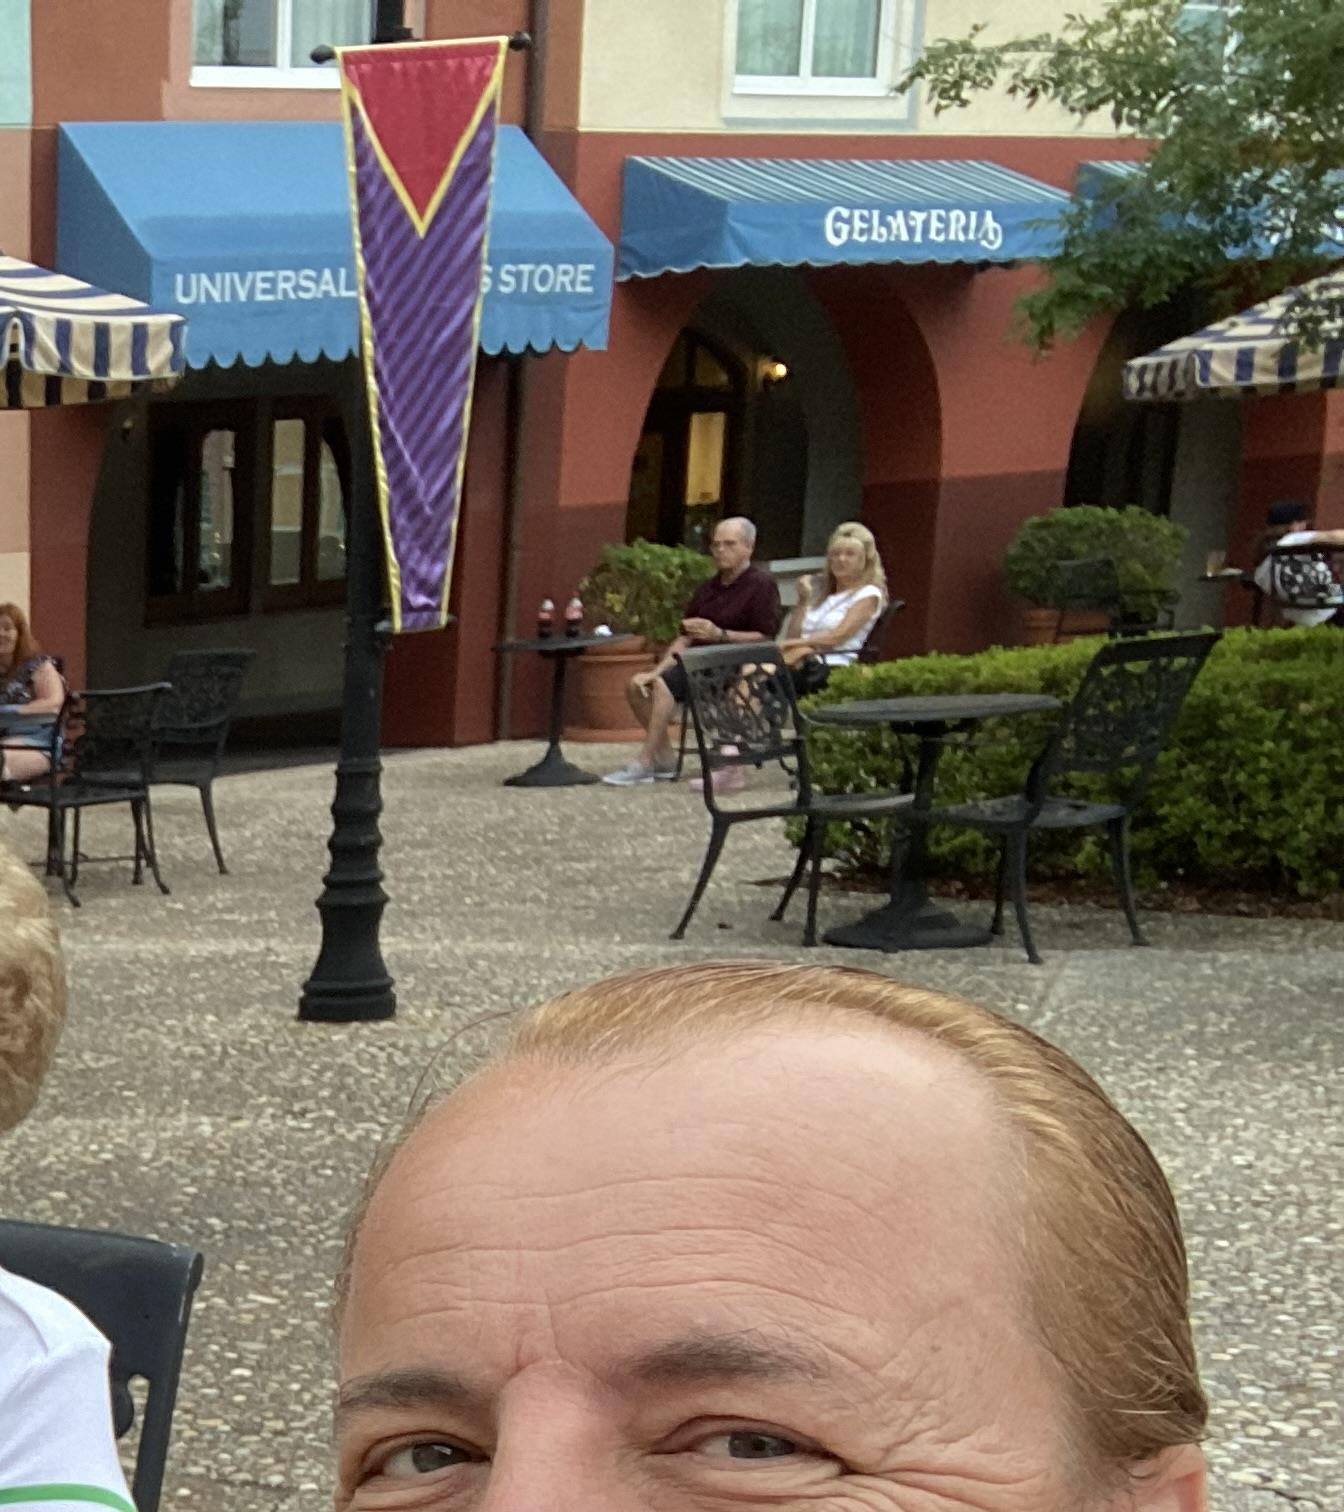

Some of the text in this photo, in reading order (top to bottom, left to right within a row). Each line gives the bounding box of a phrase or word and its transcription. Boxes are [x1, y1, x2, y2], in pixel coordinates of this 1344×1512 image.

[824, 205, 1004, 251] GELATERIA
[174, 267, 358, 305] UNIVERSAL
[497, 263, 596, 294] STORE
